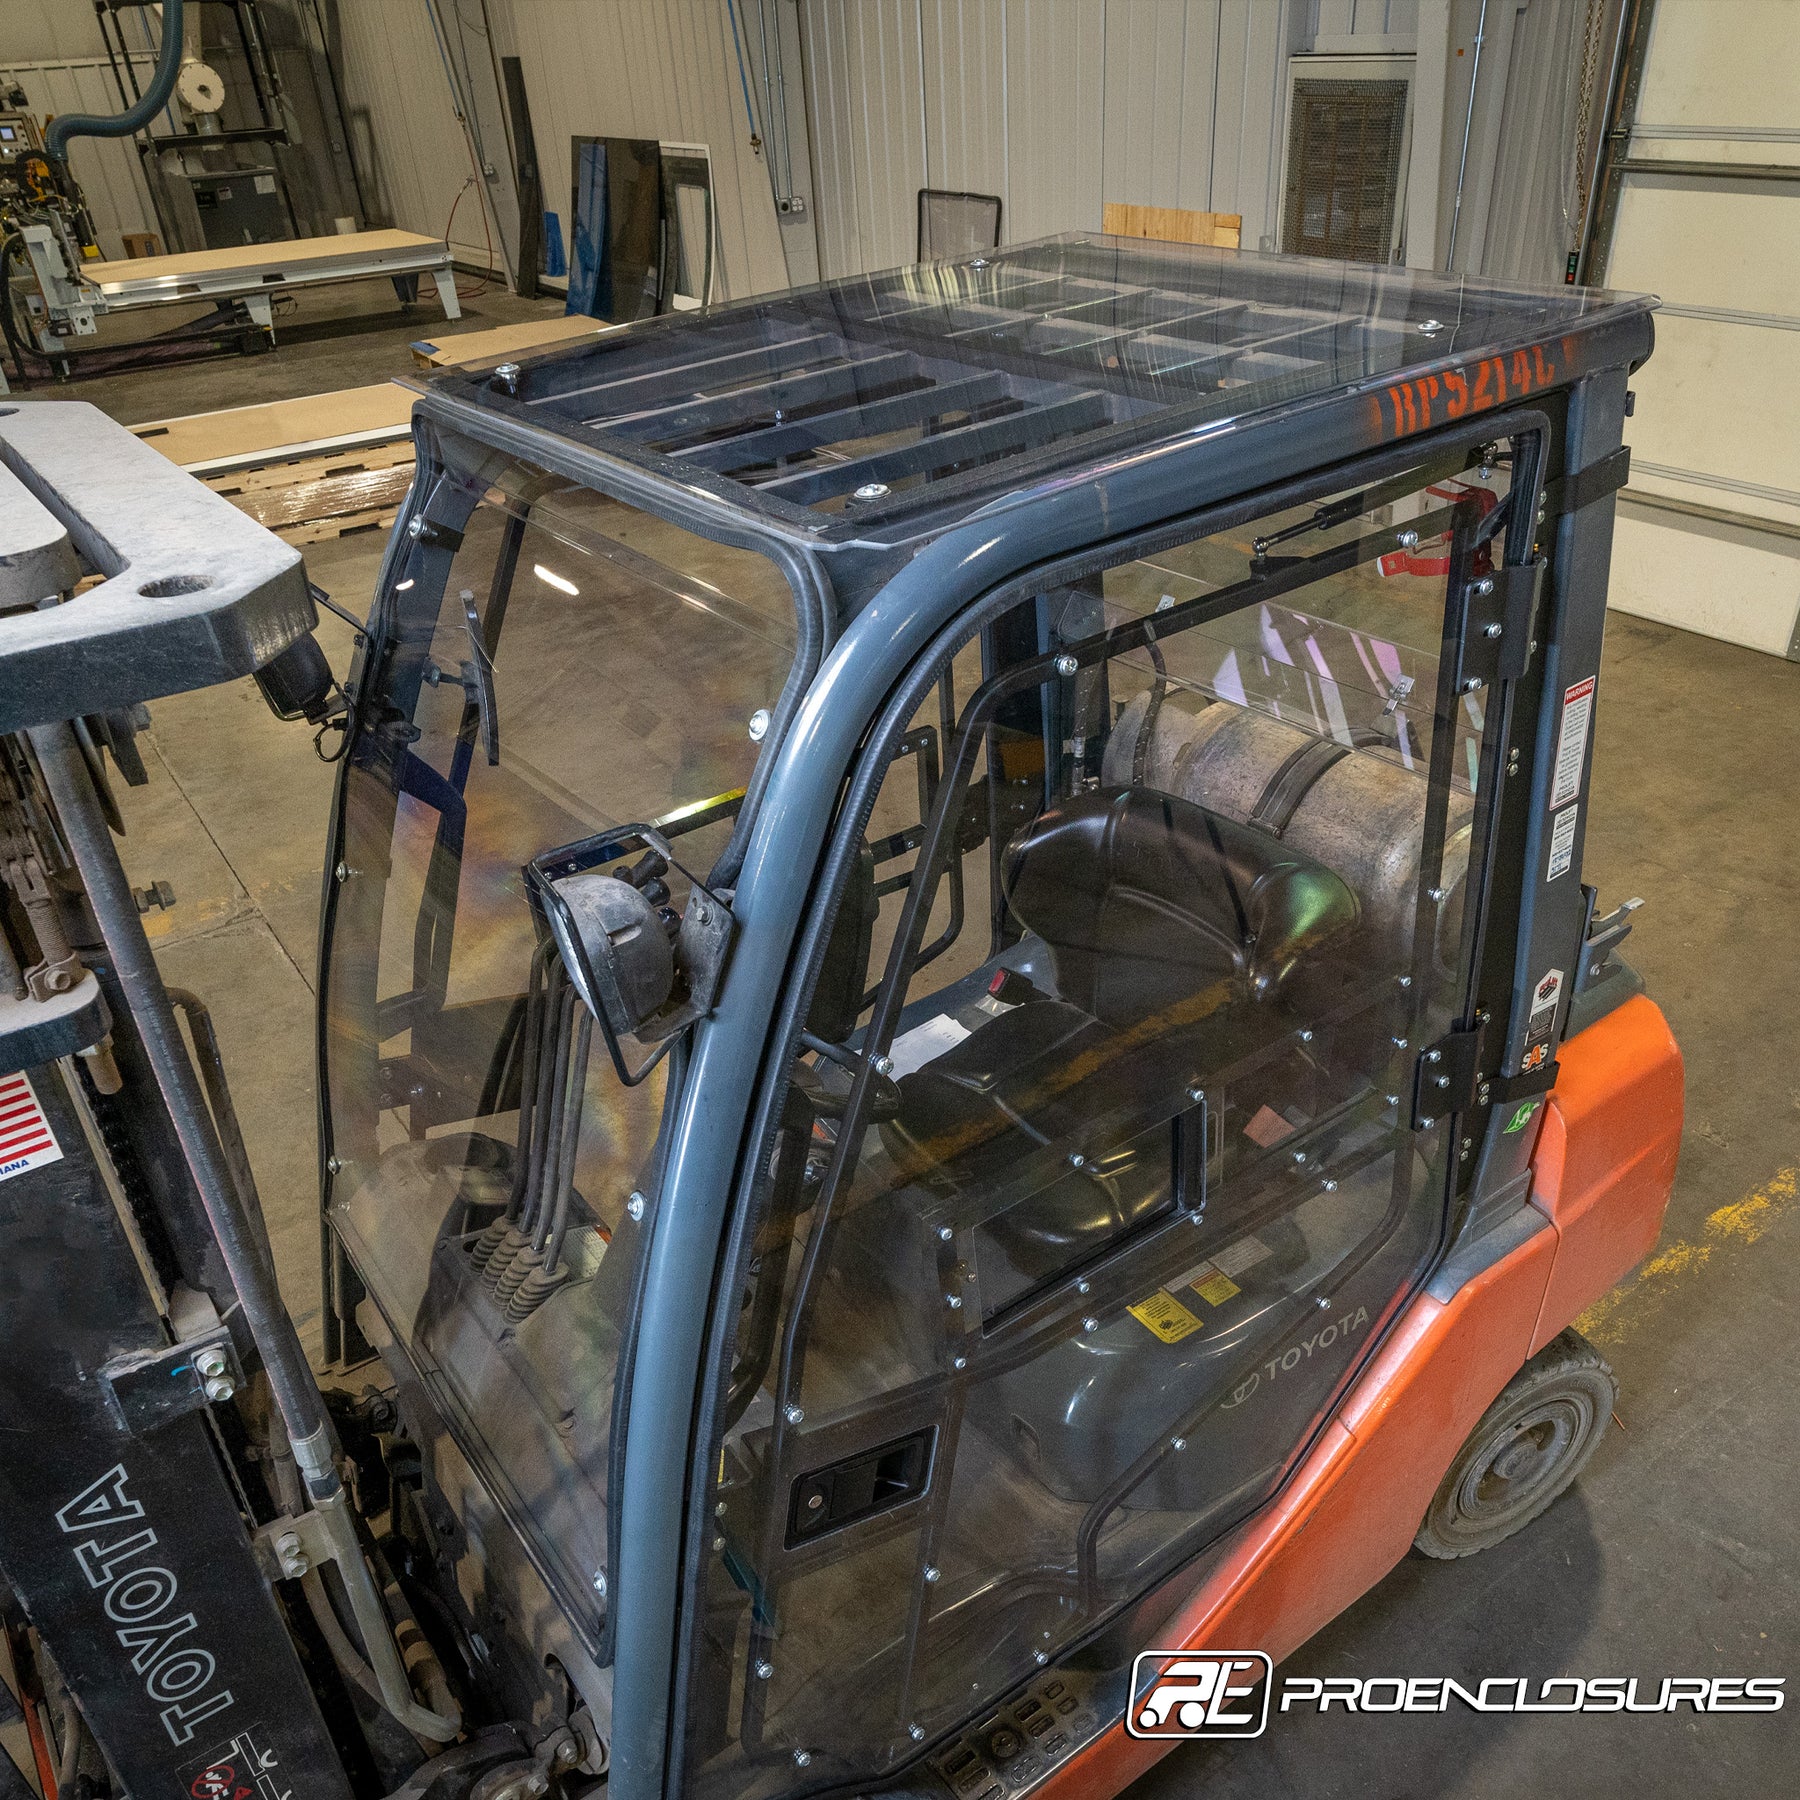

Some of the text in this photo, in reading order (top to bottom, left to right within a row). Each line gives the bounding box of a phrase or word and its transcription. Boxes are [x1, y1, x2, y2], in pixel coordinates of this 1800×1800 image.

[1566, 681, 1593, 700] WARNING
[1521, 1043, 1549, 1070] SAS
[1265, 1306, 1369, 1380] TOYOTA
[55, 1463, 234, 1746] TOYOTA
